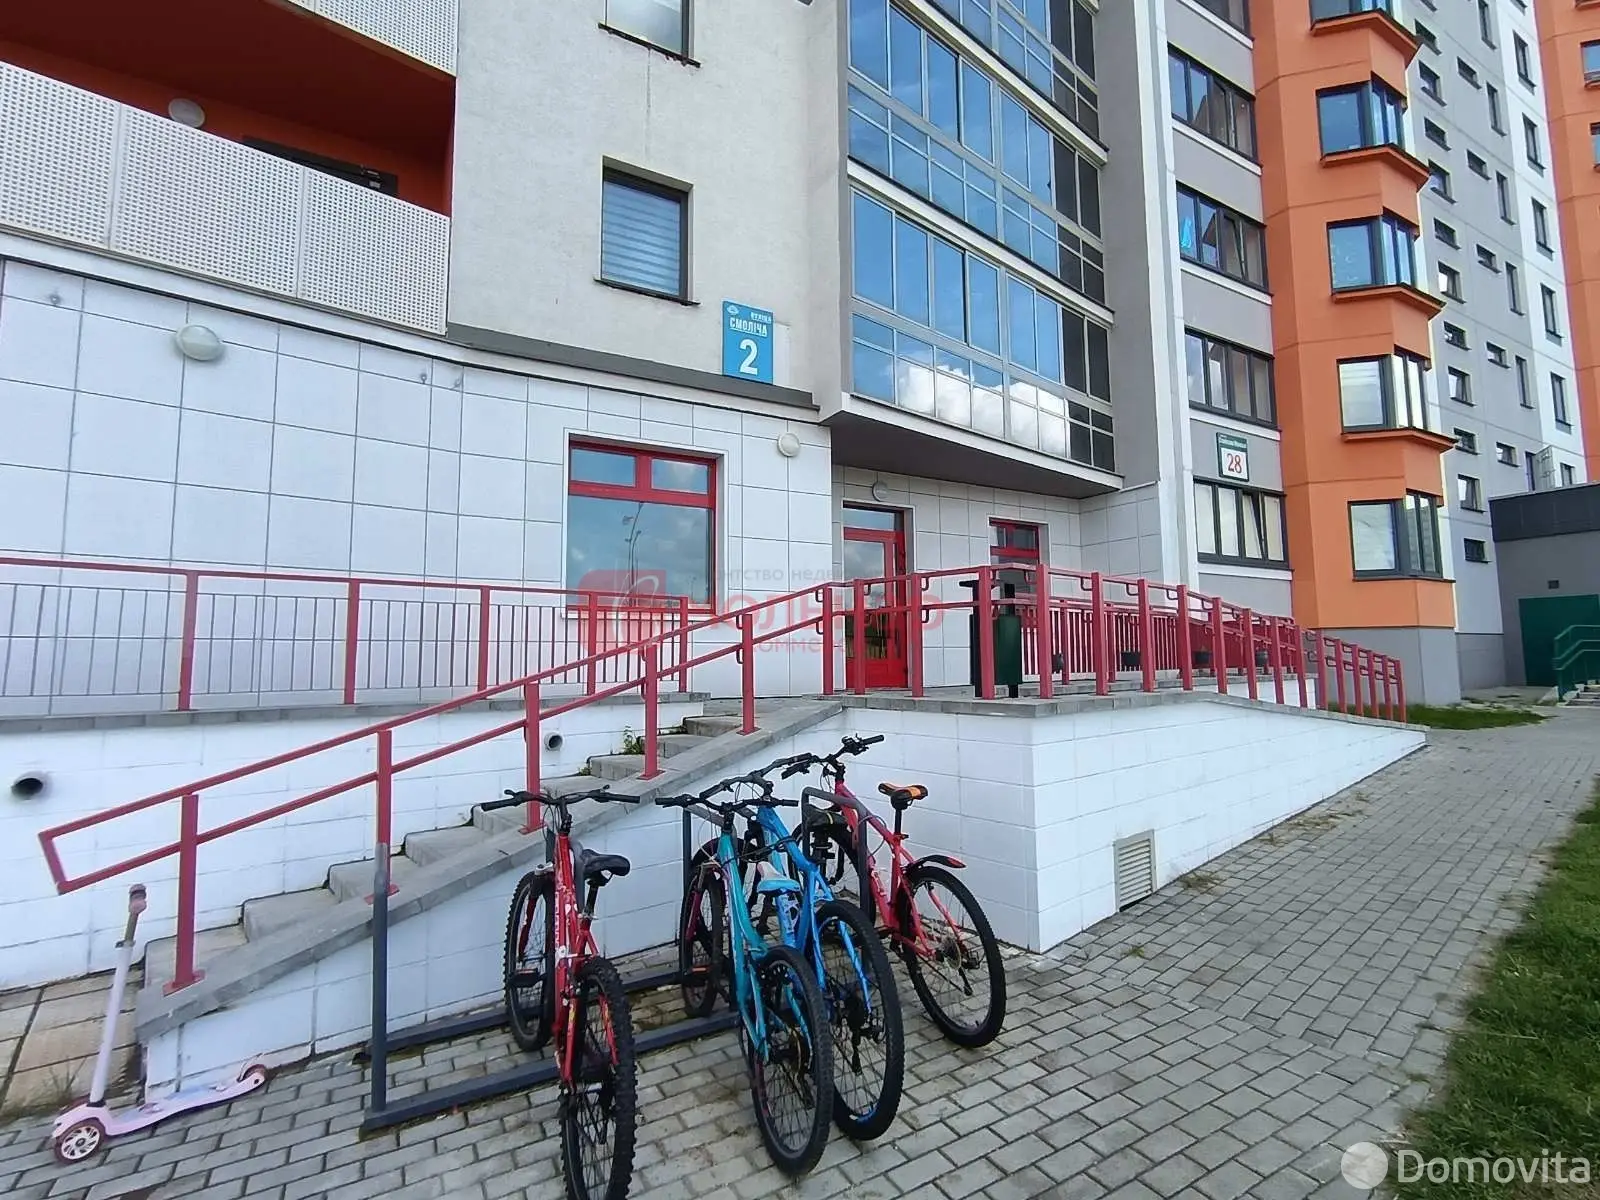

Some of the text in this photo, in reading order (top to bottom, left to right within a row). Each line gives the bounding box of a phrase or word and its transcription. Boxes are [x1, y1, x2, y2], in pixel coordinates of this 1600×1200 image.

[729, 317, 768, 336] СМОЛІЧА
[739, 338, 758, 375] 2
[1227, 453, 1242, 473] 28
